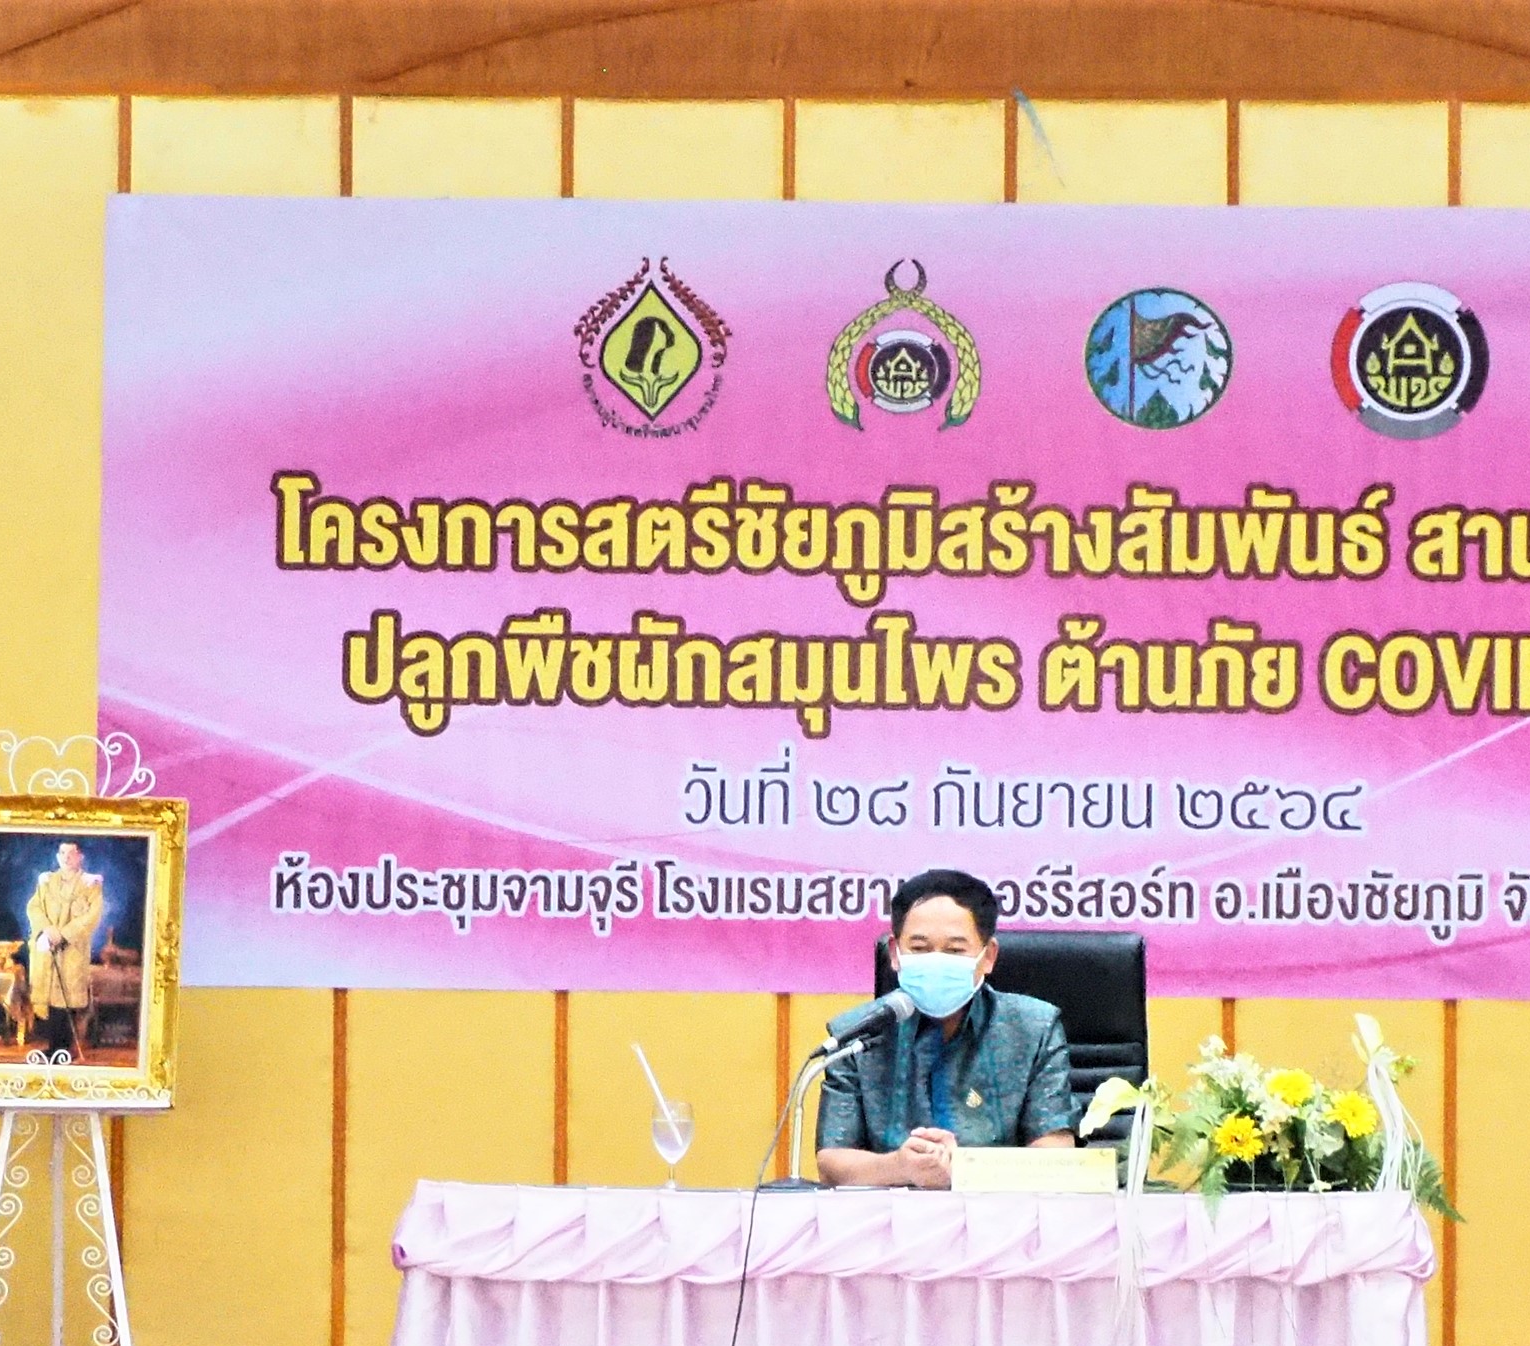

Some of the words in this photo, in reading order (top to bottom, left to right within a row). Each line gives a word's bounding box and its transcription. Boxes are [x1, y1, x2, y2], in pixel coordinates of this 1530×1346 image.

[276, 474, 1391, 602] โครงการสตรีชัยภูมิสร้างสัมพันธ์
[346, 611, 1016, 733] ปลูกพืชผักสมุนไพร
[1045, 618, 1299, 711] ต้านภัย
[684, 747, 791, 827] วันที่
[813, 780, 909, 827] ๒๘
[932, 766, 1153, 829] กันยายน
[1176, 781, 1362, 830] ๒๕๖๔
[275, 856, 639, 931] ห้องประชุมจามจุรี
[1215, 867, 1483, 941] อ.เมืองชัยภูมิ
